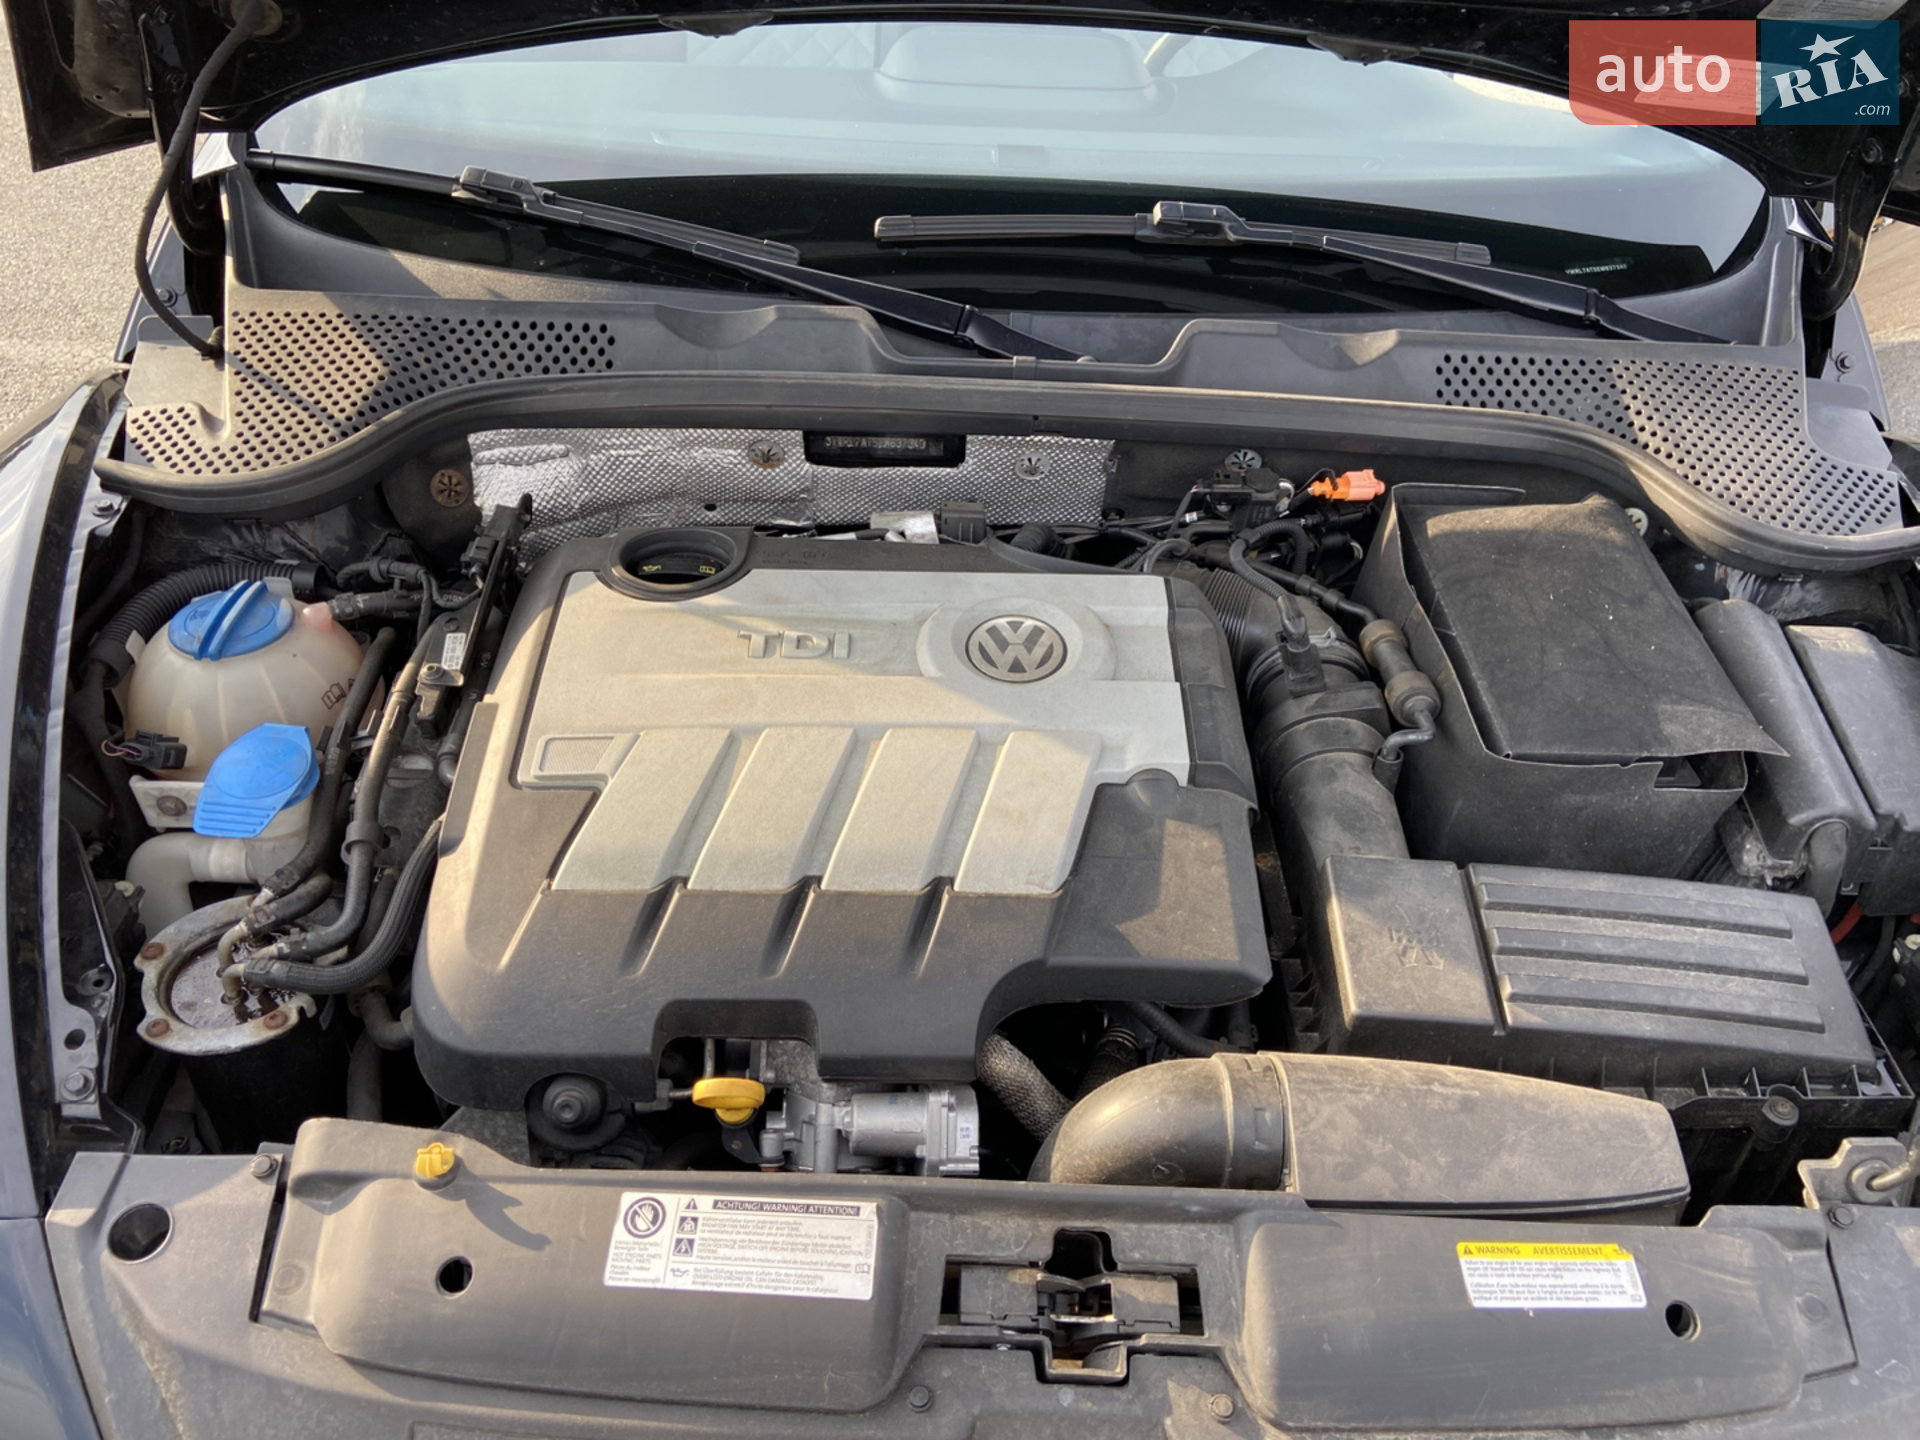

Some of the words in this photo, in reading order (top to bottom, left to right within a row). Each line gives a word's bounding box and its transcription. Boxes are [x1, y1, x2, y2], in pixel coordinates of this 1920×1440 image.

[737, 629, 851, 659] TDI
[715, 1201, 761, 1210] ACHTUNG!
[762, 1203, 806, 1213] WARNING!
[808, 1205, 858, 1215] ATTENTION!
[1475, 1246, 1520, 1254] WARNING
[1532, 1247, 1603, 1255] AVERTISSEMENT
